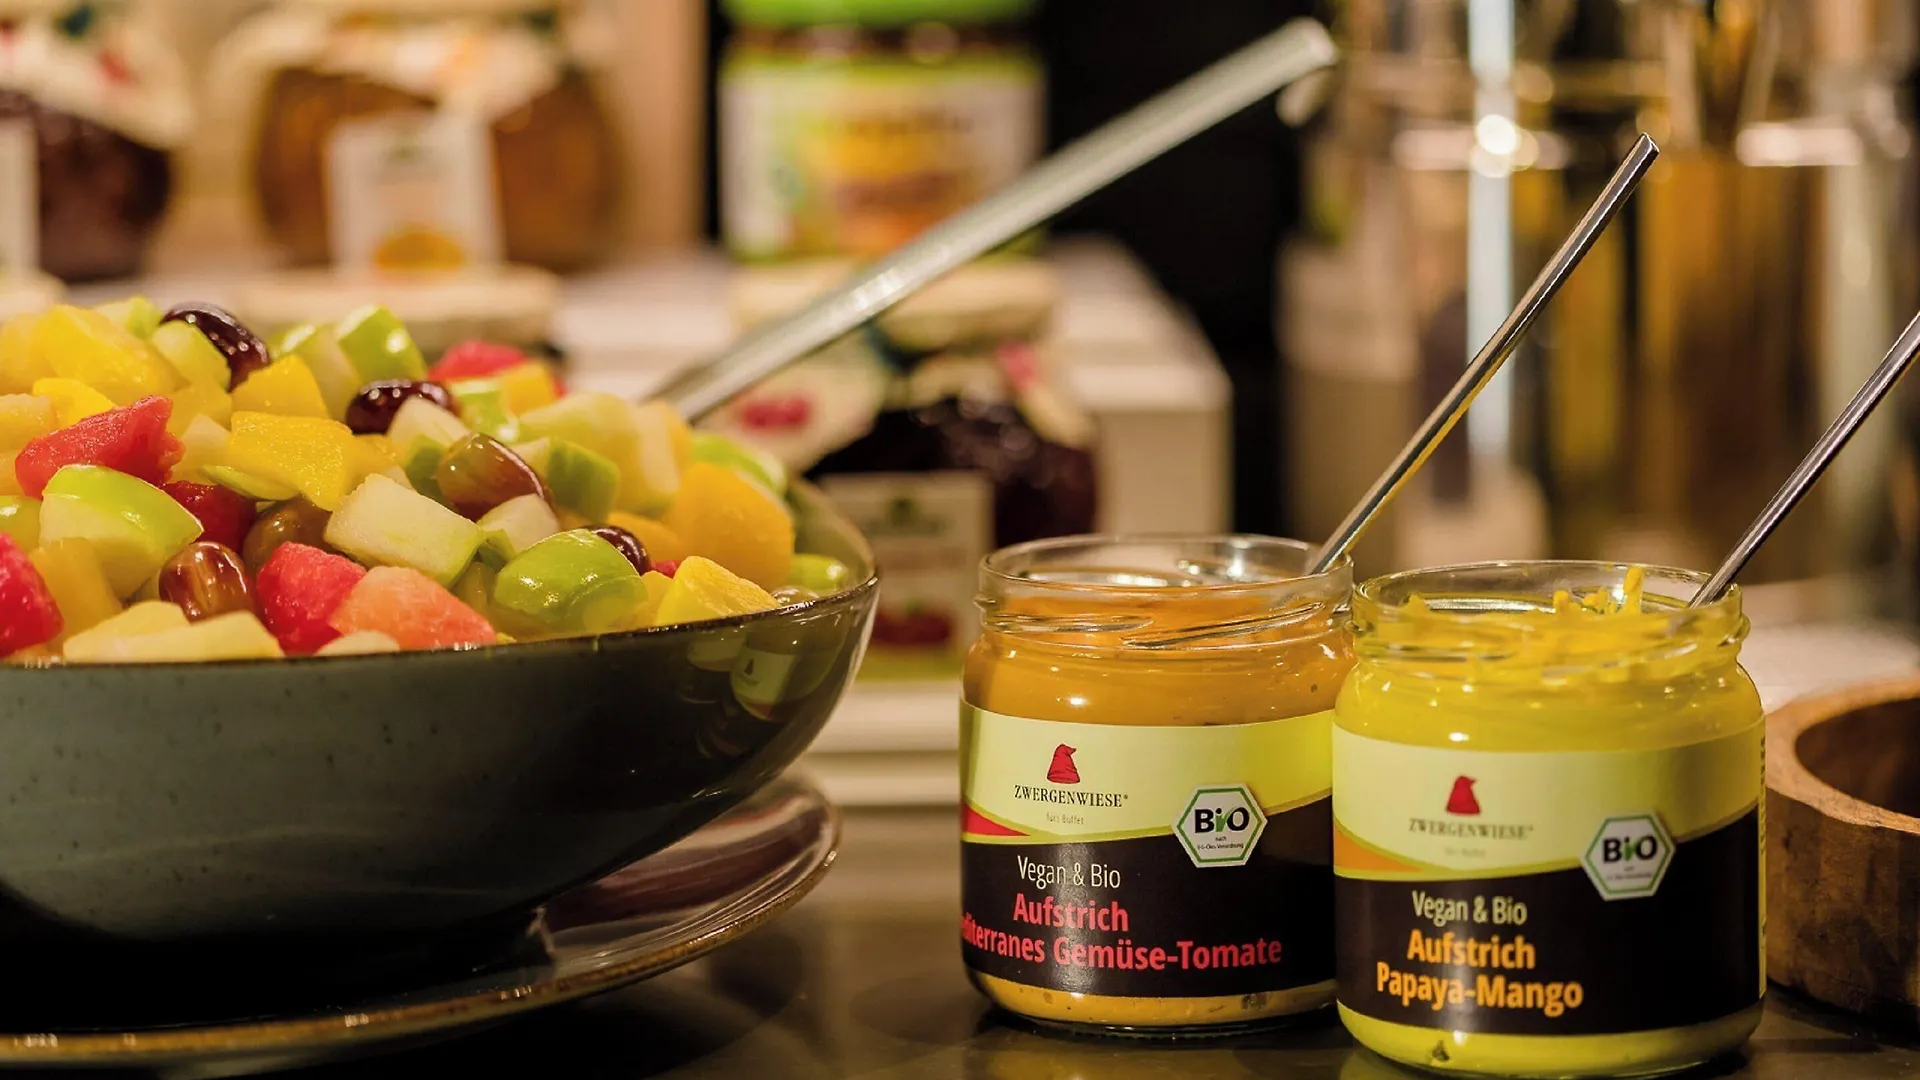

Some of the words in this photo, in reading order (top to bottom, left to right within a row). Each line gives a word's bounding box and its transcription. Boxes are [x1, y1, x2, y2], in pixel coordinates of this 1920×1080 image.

[1017, 854, 1066, 890] Vegan
[1073, 862, 1086, 887] &
[1091, 863, 1121, 889] Bio
[1013, 893, 1129, 932] Aufstrich
[1411, 889, 1468, 927] Vegan
[1473, 895, 1488, 924] &
[1492, 896, 1528, 926] Bio
[1053, 937, 1283, 971] Gemüse-Tomate
[1407, 928, 1537, 970] Aufstrich
[1376, 960, 1584, 1018] Papaya-Mango
